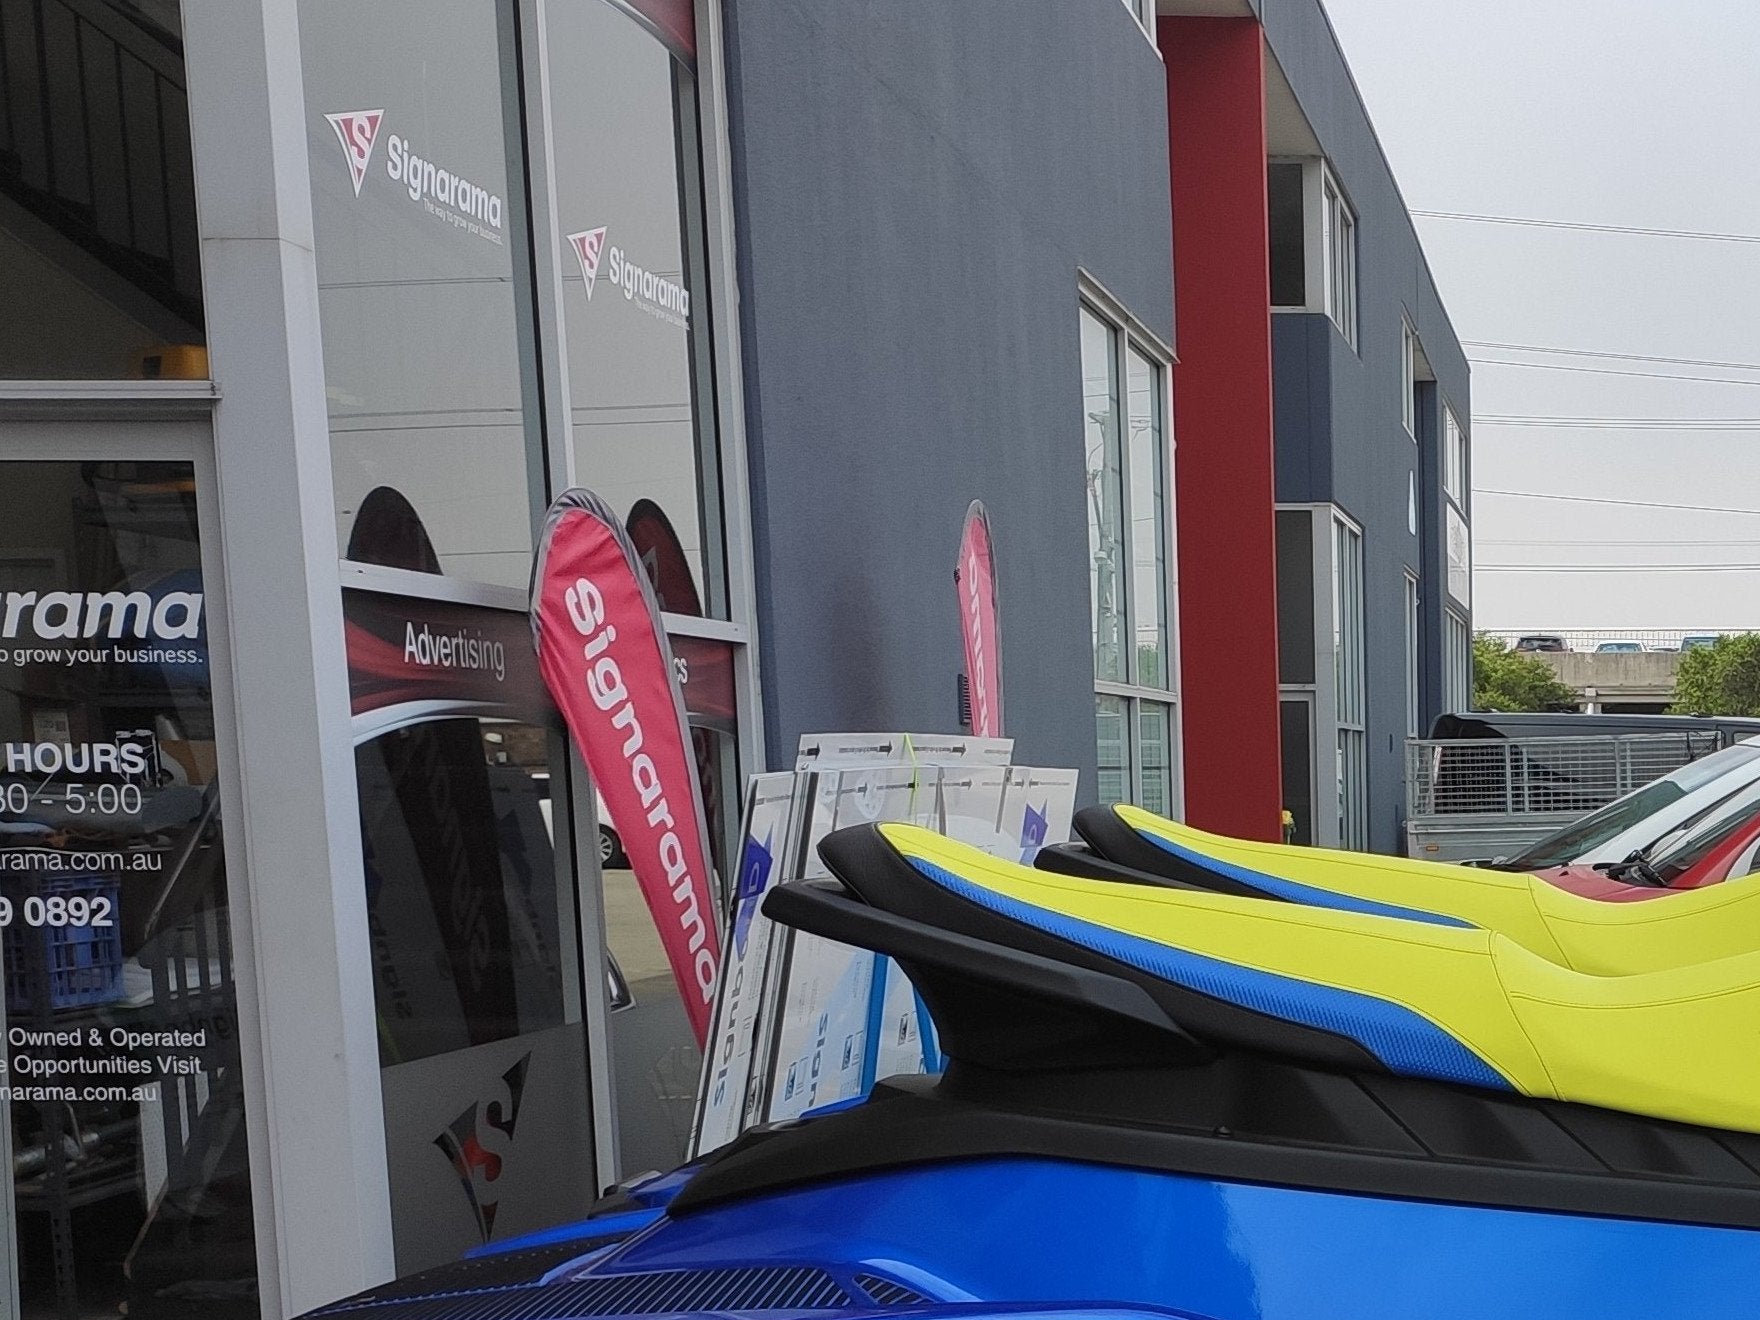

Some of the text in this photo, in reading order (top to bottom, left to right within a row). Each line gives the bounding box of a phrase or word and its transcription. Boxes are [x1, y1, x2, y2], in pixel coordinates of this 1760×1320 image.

[386, 134, 501, 229] Signarama
[608, 246, 689, 317] Signarama
[0, 591, 203, 640] rama
[14, 649, 61, 667] grow
[66, 649, 112, 667] your
[114, 645, 203, 663] business.
[404, 621, 505, 682] Advertising
[6, 742, 145, 774] HOURS
[65, 783, 142, 814] 5:00
[564, 577, 718, 1006] Signarama
[0, 852, 162, 871] rama.com.au
[23, 896, 113, 927] 0892
[8, 1027, 206, 1050] Owned & Operated
[14, 1054, 152, 1078] Opportunities
[157, 1055, 202, 1075] Visit
